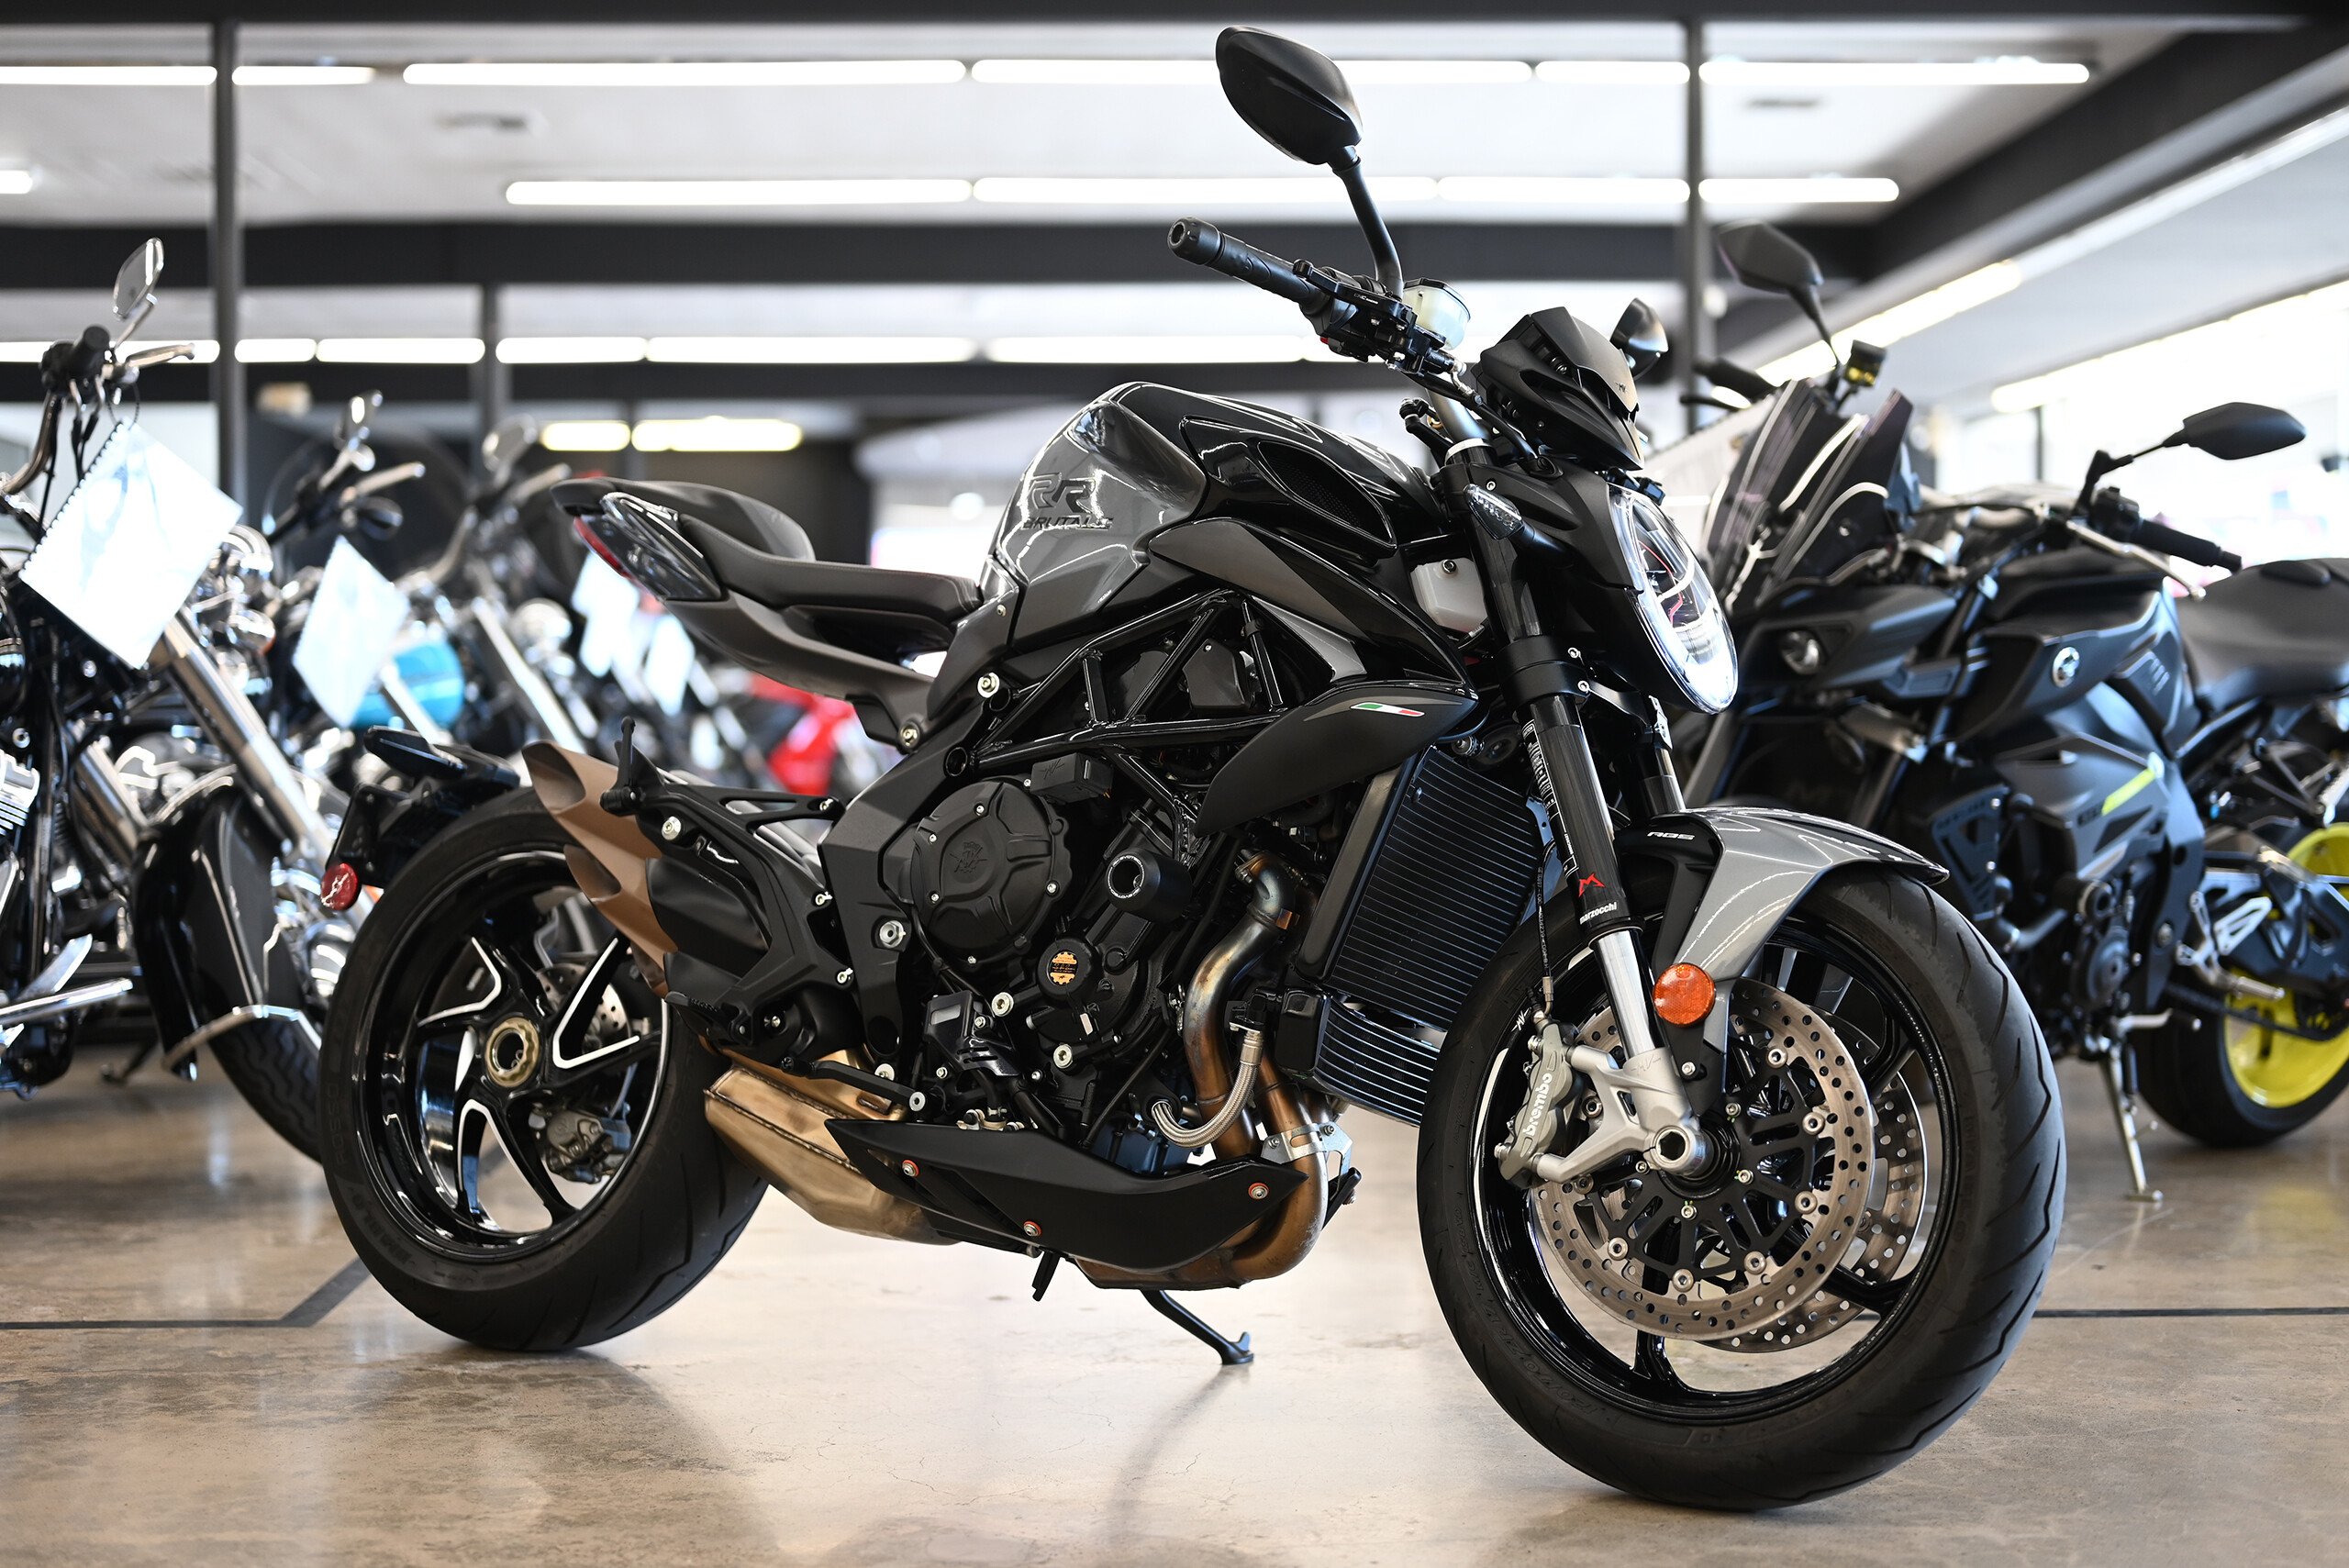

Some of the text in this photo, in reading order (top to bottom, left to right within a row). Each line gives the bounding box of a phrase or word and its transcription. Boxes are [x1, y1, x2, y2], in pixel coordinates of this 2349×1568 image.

[1027, 472, 1097, 515] RR
[1646, 831, 1696, 841] ABS
[1579, 901, 1618, 926] marzocchi
[1522, 1073, 1553, 1137] brembo
